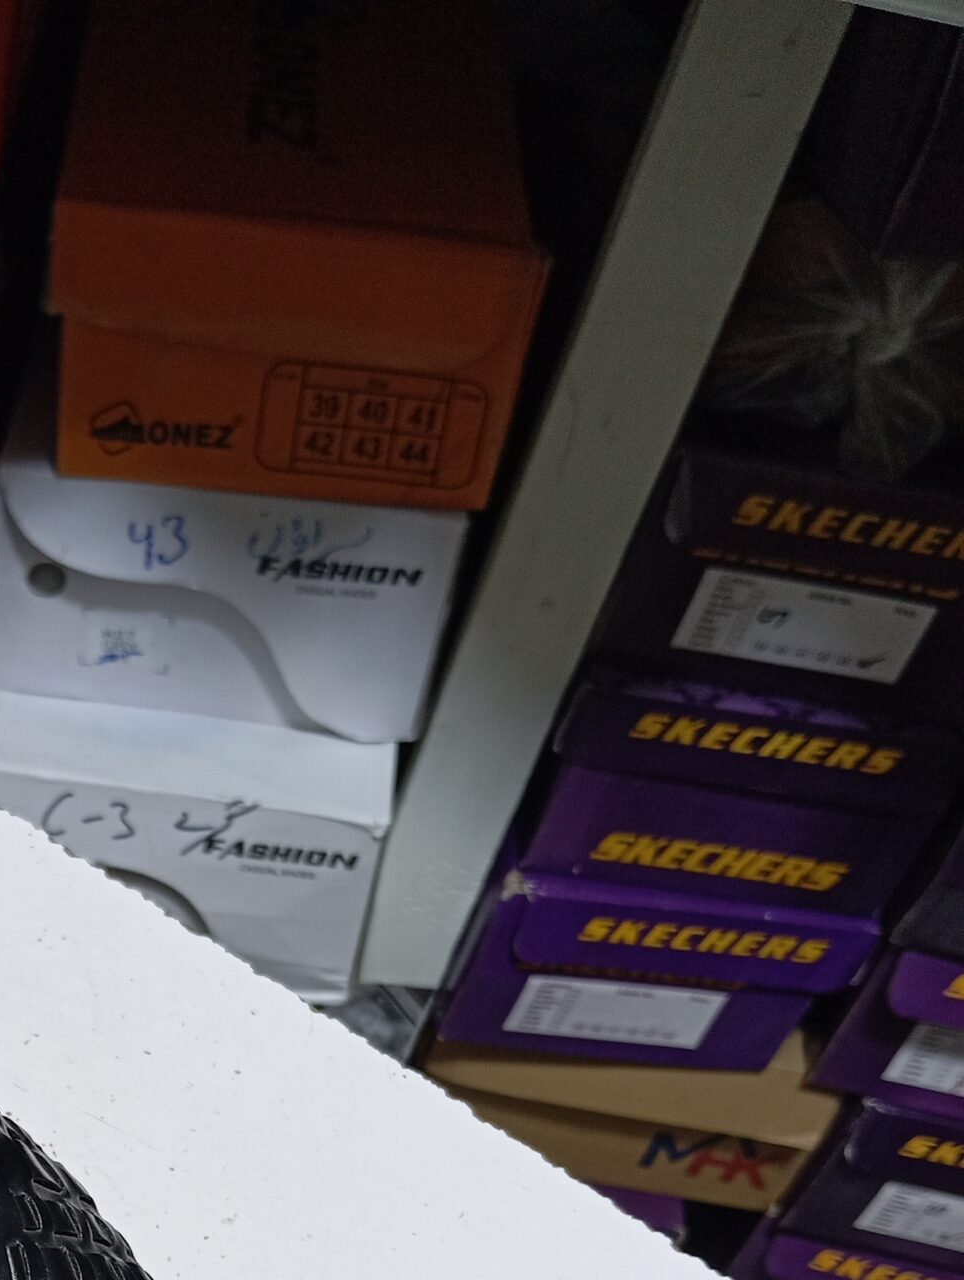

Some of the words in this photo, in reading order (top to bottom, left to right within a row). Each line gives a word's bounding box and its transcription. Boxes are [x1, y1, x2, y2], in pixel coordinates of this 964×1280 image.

[256, 555, 423, 587] FASHION
[629, 711, 905, 776] SKECHERS
[202, 834, 359, 870] FASHION
[589, 831, 849, 891] SKECHERS
[577, 916, 832, 964] SKECHERS
